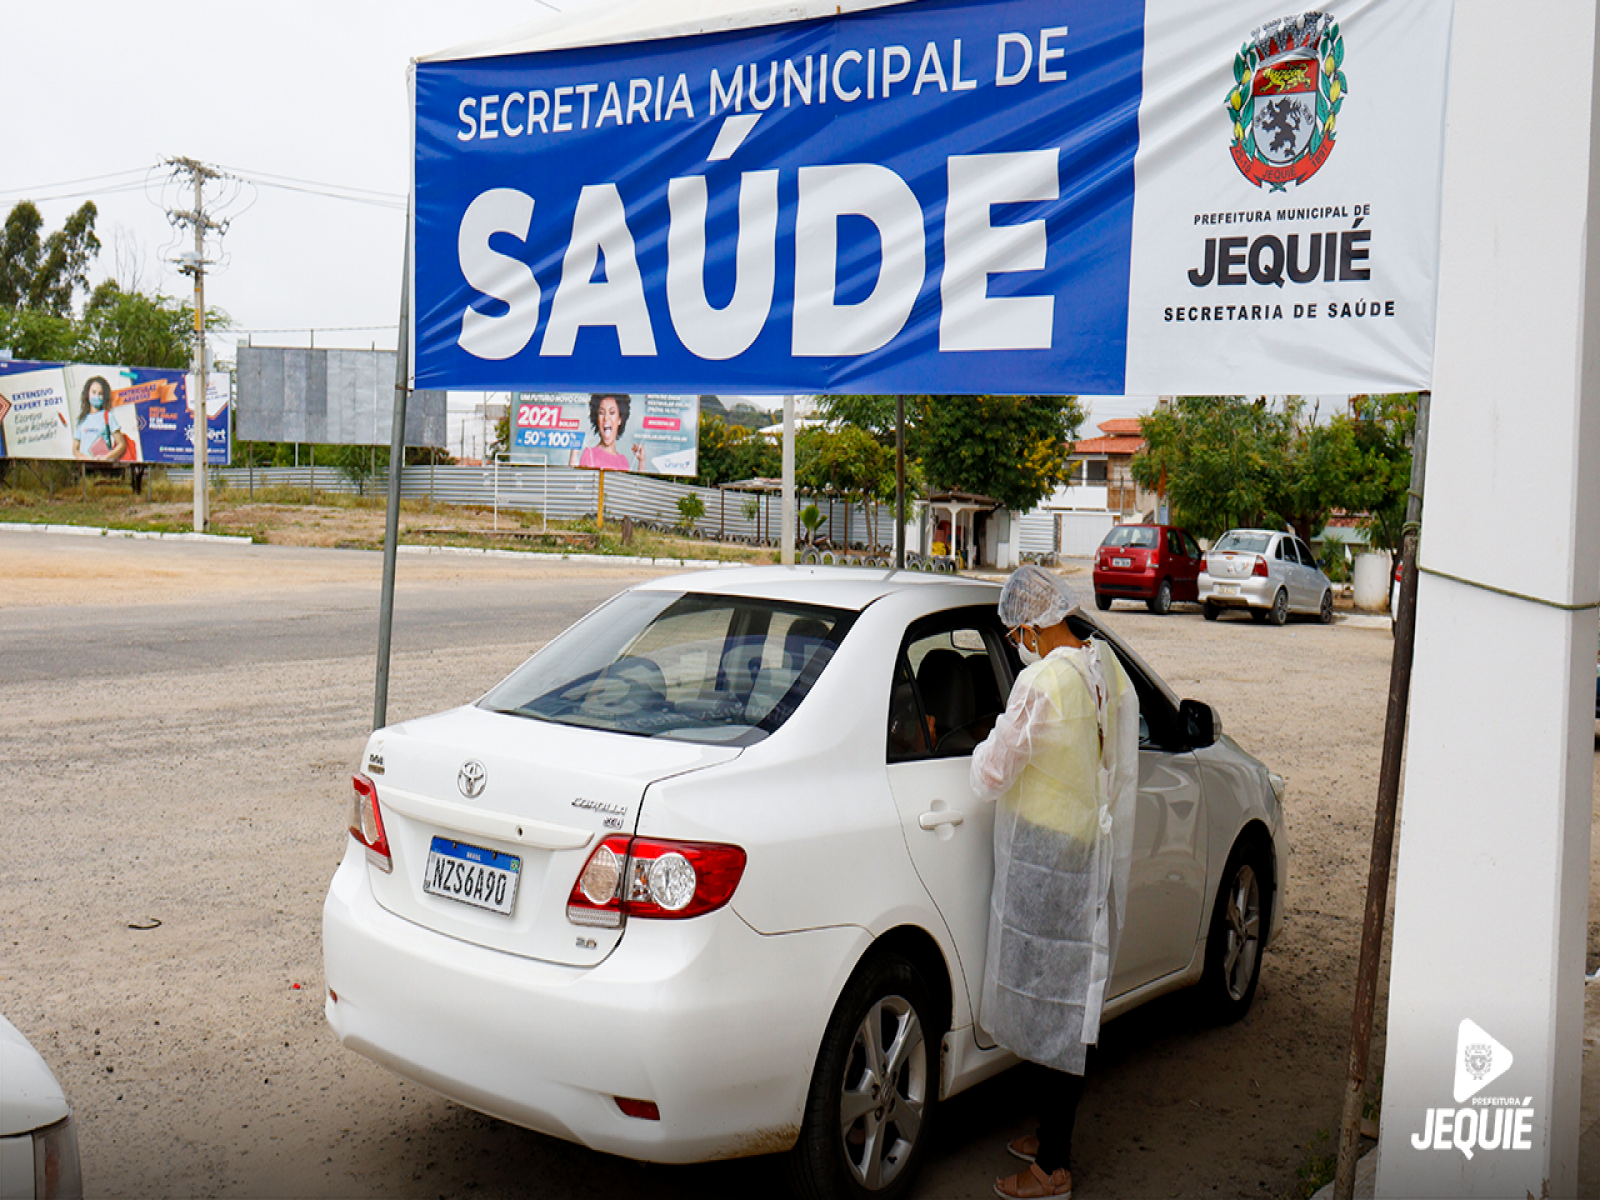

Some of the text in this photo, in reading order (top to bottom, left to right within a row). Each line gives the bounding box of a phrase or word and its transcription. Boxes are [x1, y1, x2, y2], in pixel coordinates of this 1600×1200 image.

[458, 26, 1069, 142] SECRETARIA MUNICIPAL DE
[1262, 166, 1297, 179] JEQUIÉ
[1194, 203, 1371, 225] PREFEITURA MUNICIPAL DE
[457, 113, 1061, 361] SAÚDE
[1187, 217, 1372, 289] JEQUIÉ
[1164, 298, 1395, 321] SECRETARIA DE SAÚDE
[12, 387, 54, 402] EXTENSIVO
[14, 396, 63, 412] EXPERT 2021
[517, 404, 559, 428] 2021
[432, 857, 507, 906] NZS6A90
